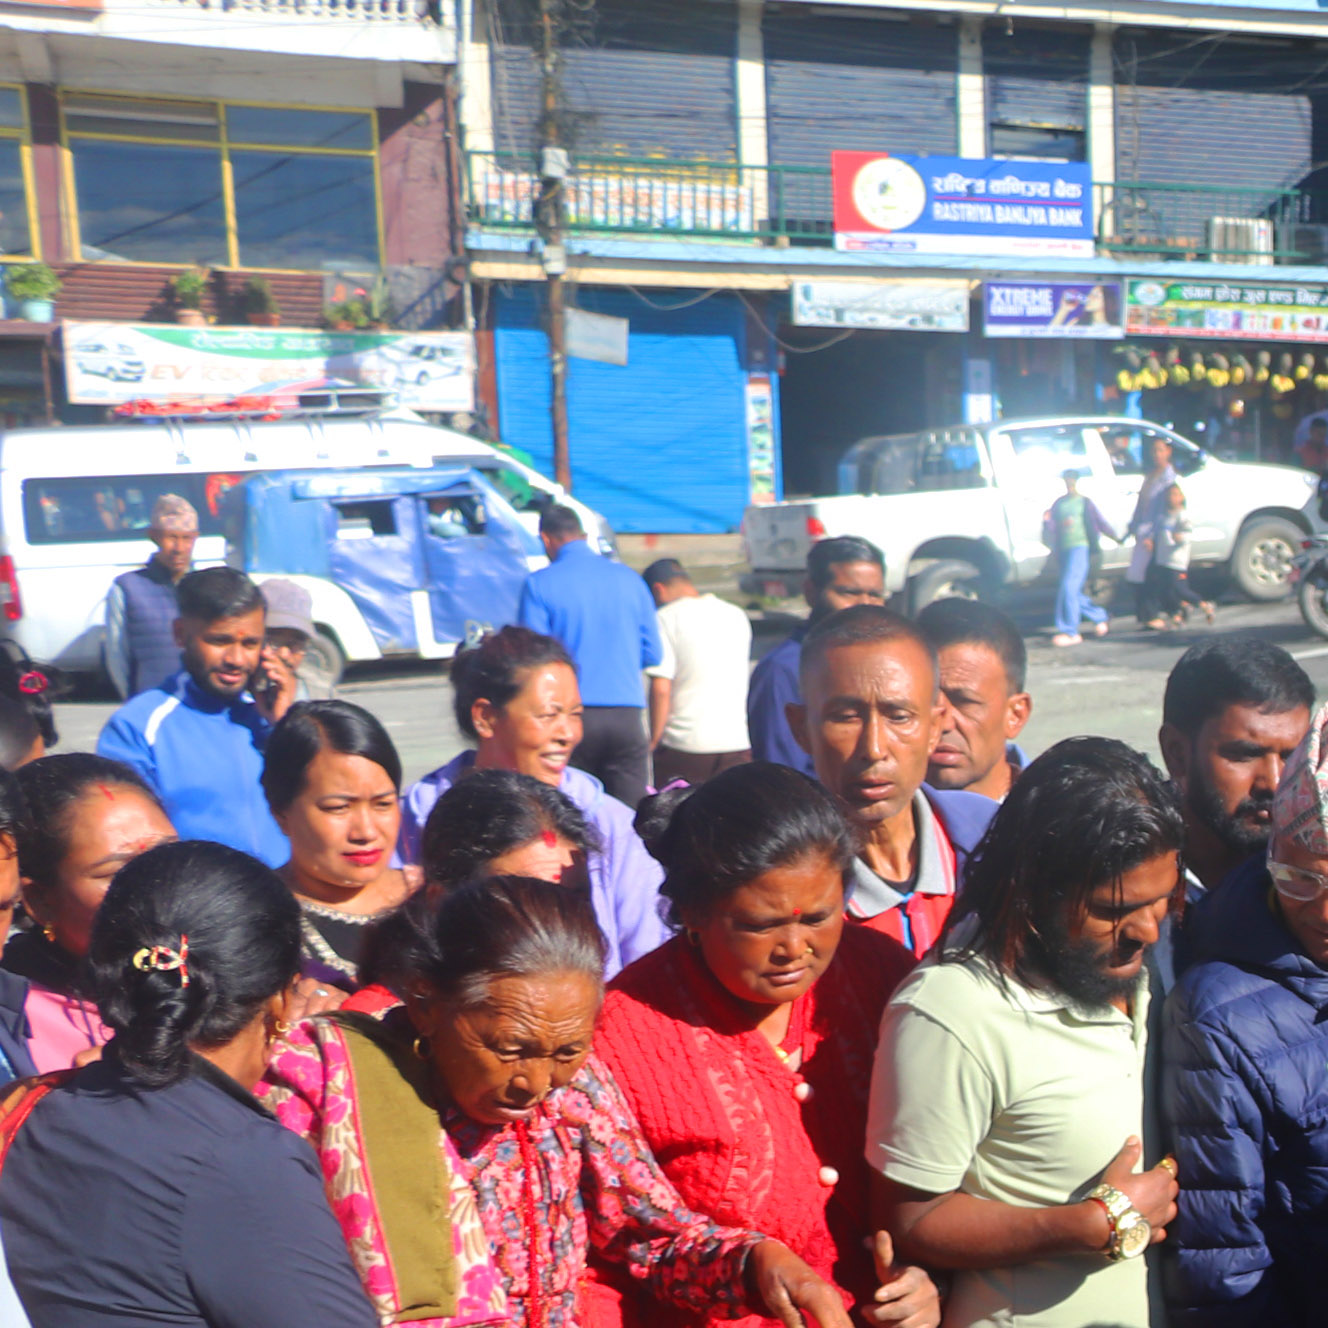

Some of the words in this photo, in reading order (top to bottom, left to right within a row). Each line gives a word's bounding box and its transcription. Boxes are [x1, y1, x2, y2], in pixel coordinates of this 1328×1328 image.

[932, 202, 994, 223] RASTRIYA
[1049, 207, 1083, 228] BANK
[990, 287, 1053, 306] XTREME
